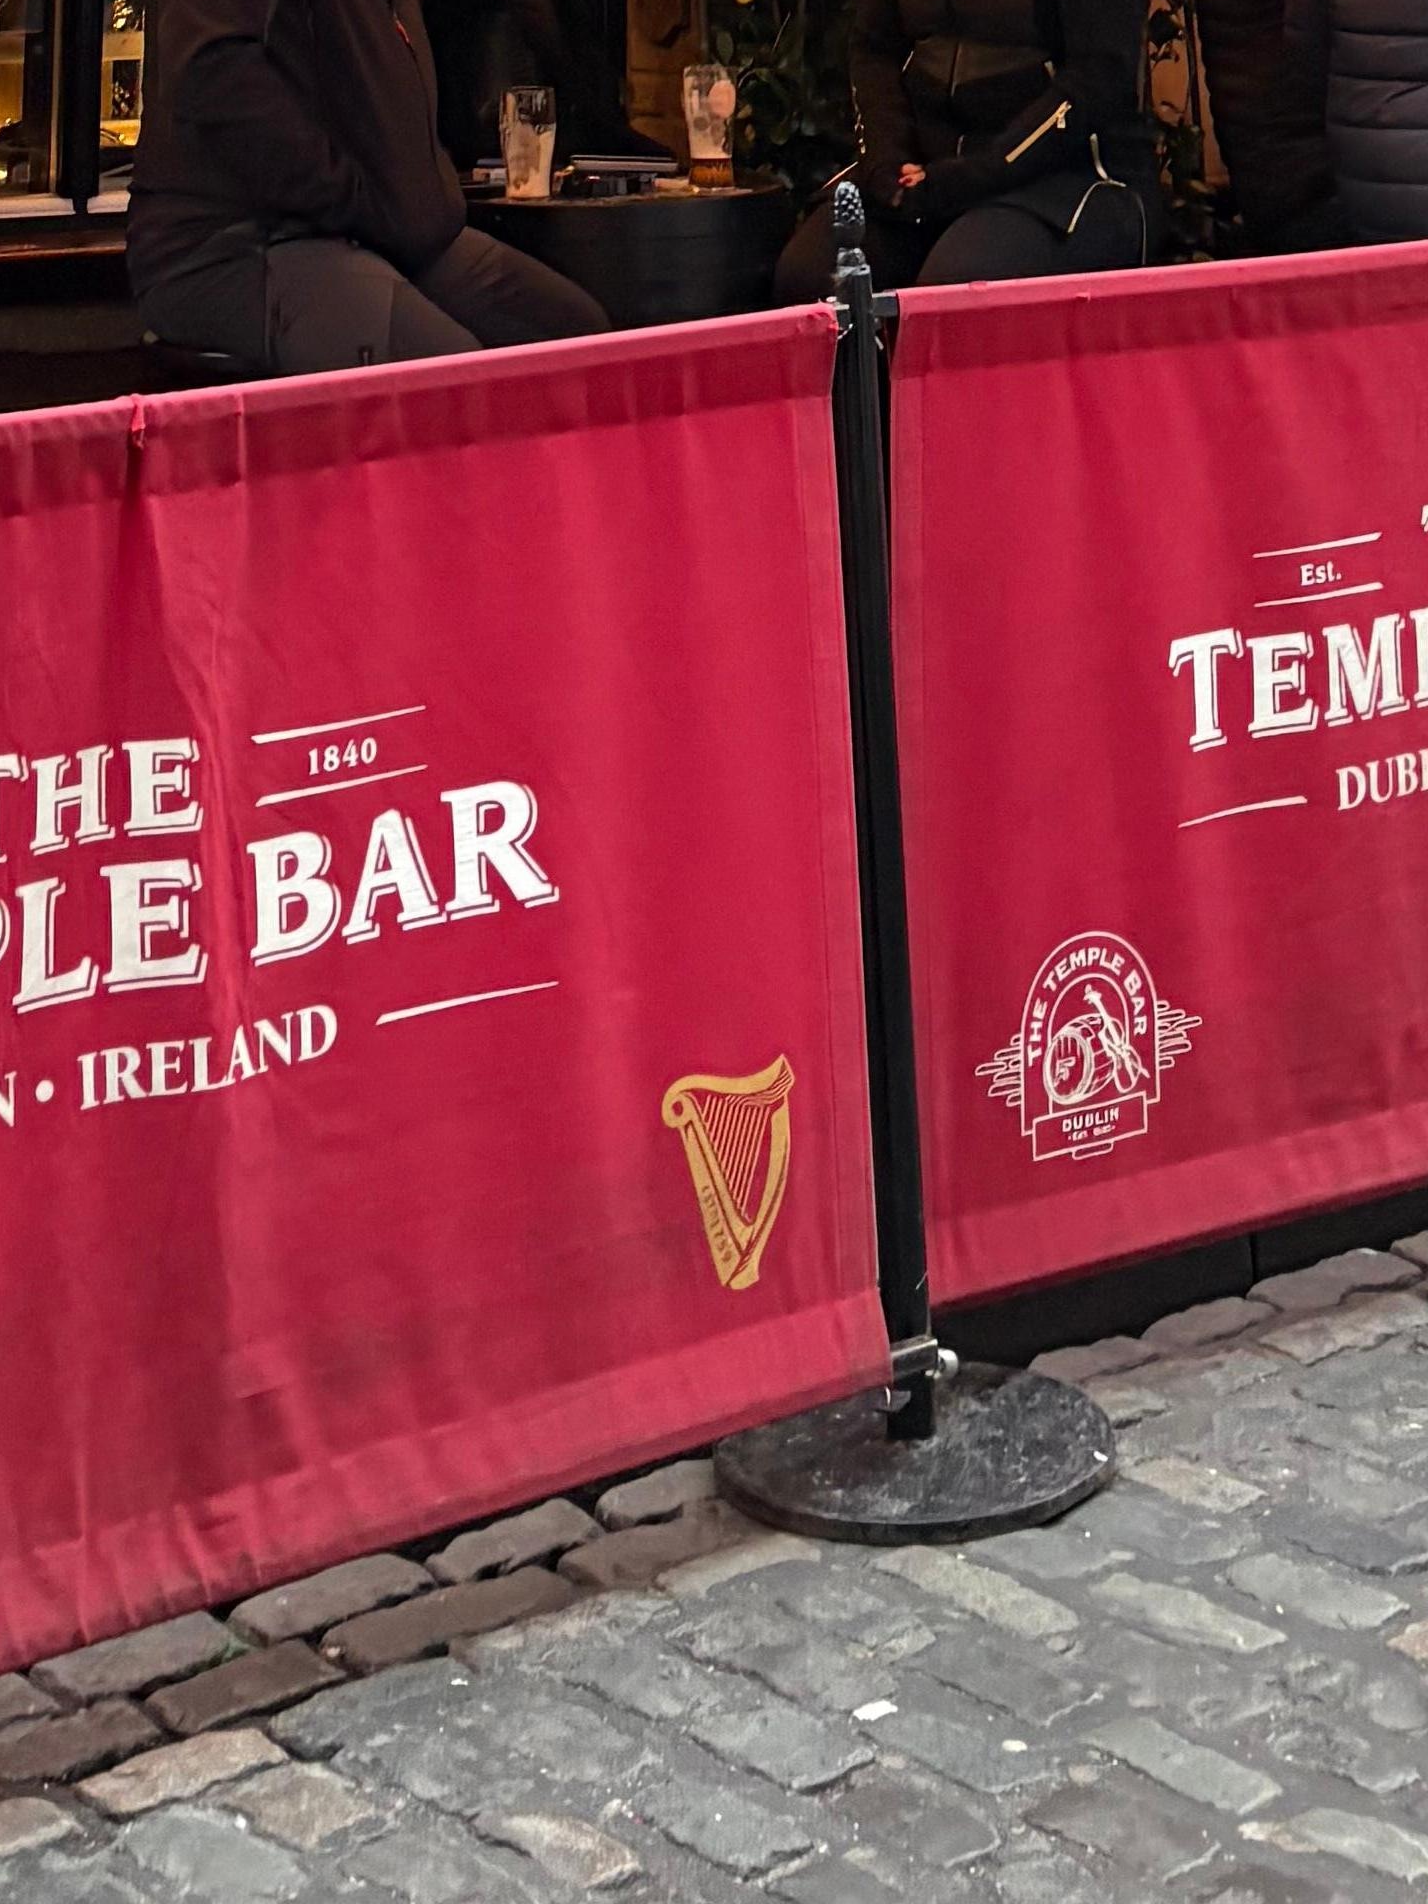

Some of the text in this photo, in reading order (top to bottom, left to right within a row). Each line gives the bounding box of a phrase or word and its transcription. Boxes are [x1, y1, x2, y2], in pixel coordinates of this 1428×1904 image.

[1301, 562, 1341, 585] Est.
[309, 738, 377, 775] 1840
[247, 782, 559, 966] BAR
[78, 1005, 337, 1109] IRELAND
[1027, 947, 1148, 1067] THE TEMPLE BAR
